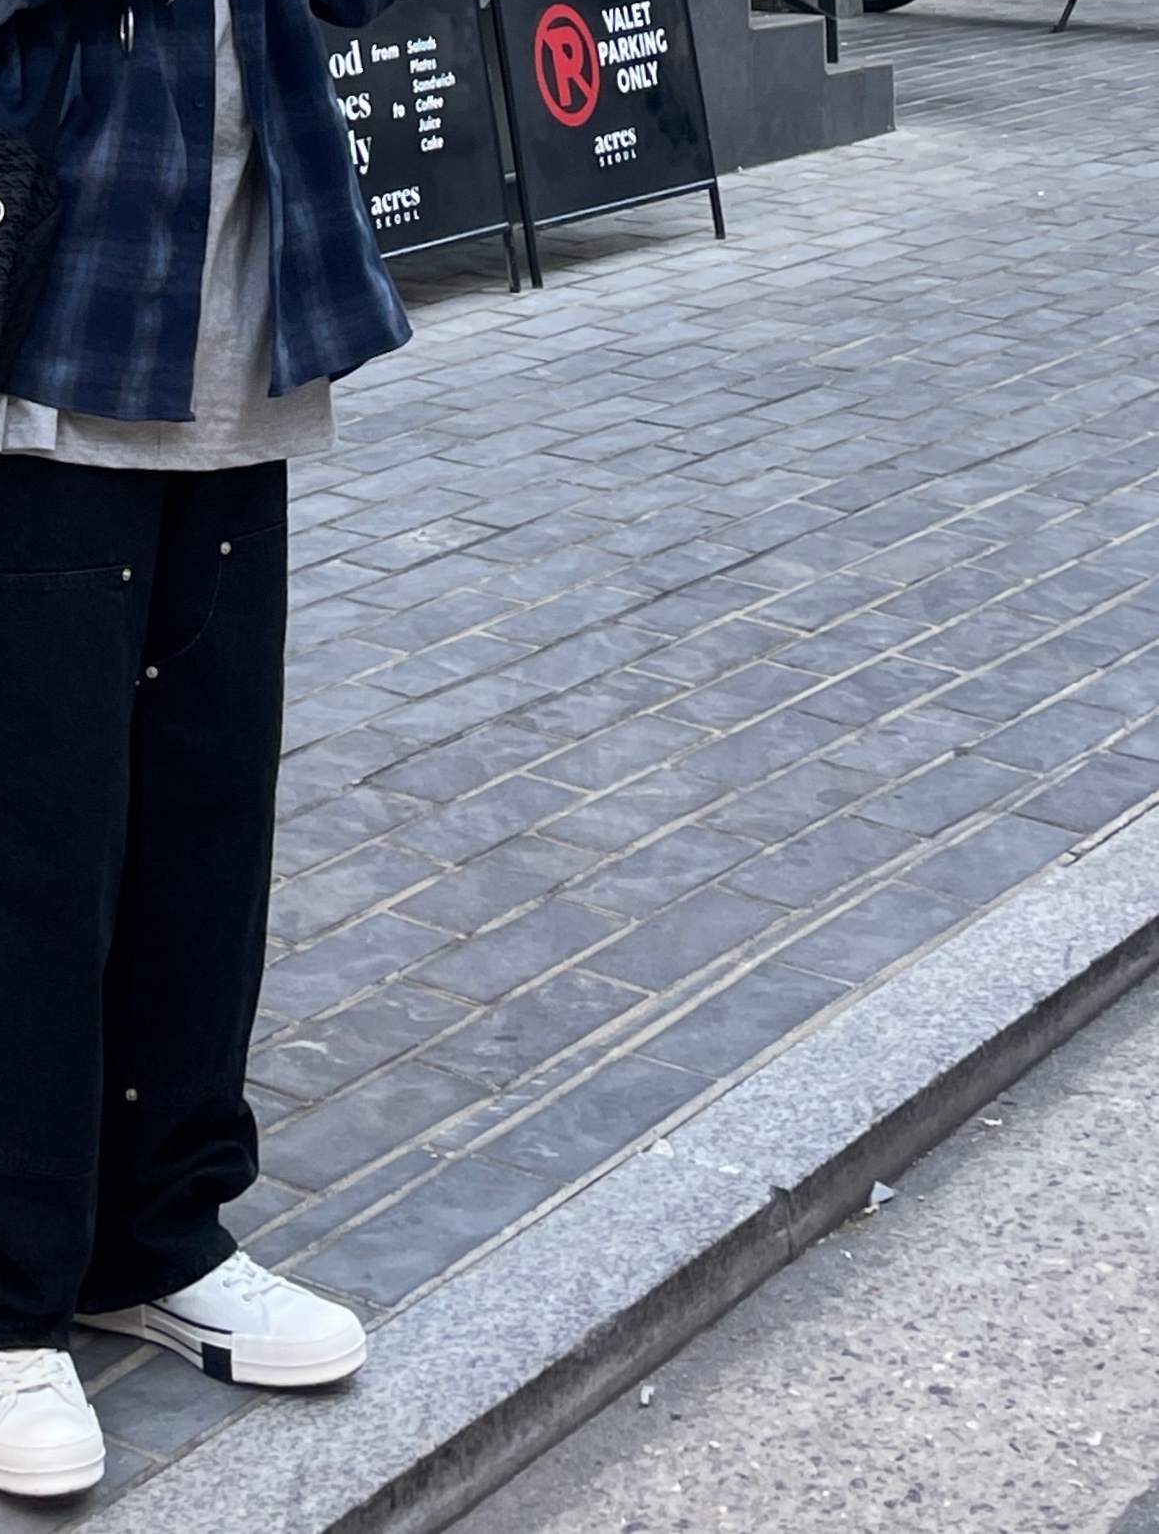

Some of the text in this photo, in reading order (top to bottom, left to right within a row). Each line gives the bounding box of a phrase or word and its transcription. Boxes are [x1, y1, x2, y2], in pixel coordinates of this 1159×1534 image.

[602, 1, 652, 34] VALET
[371, 44, 400, 63] from
[406, 35, 438, 55] Salads
[597, 28, 669, 68] PARKING
[409, 58, 438, 74] Plates
[616, 60, 659, 94] ONLY
[412, 71, 457, 94] Sandwich
[392, 102, 406, 119] to
[415, 95, 445, 113] Coffee
[418, 115, 442, 133] Juice
[420, 135, 445, 153] Cake
[594, 127, 638, 155] acres
[598, 149, 637, 168] SEOUL
[371, 186, 421, 216] acres
[375, 209, 420, 230] SEOUL
